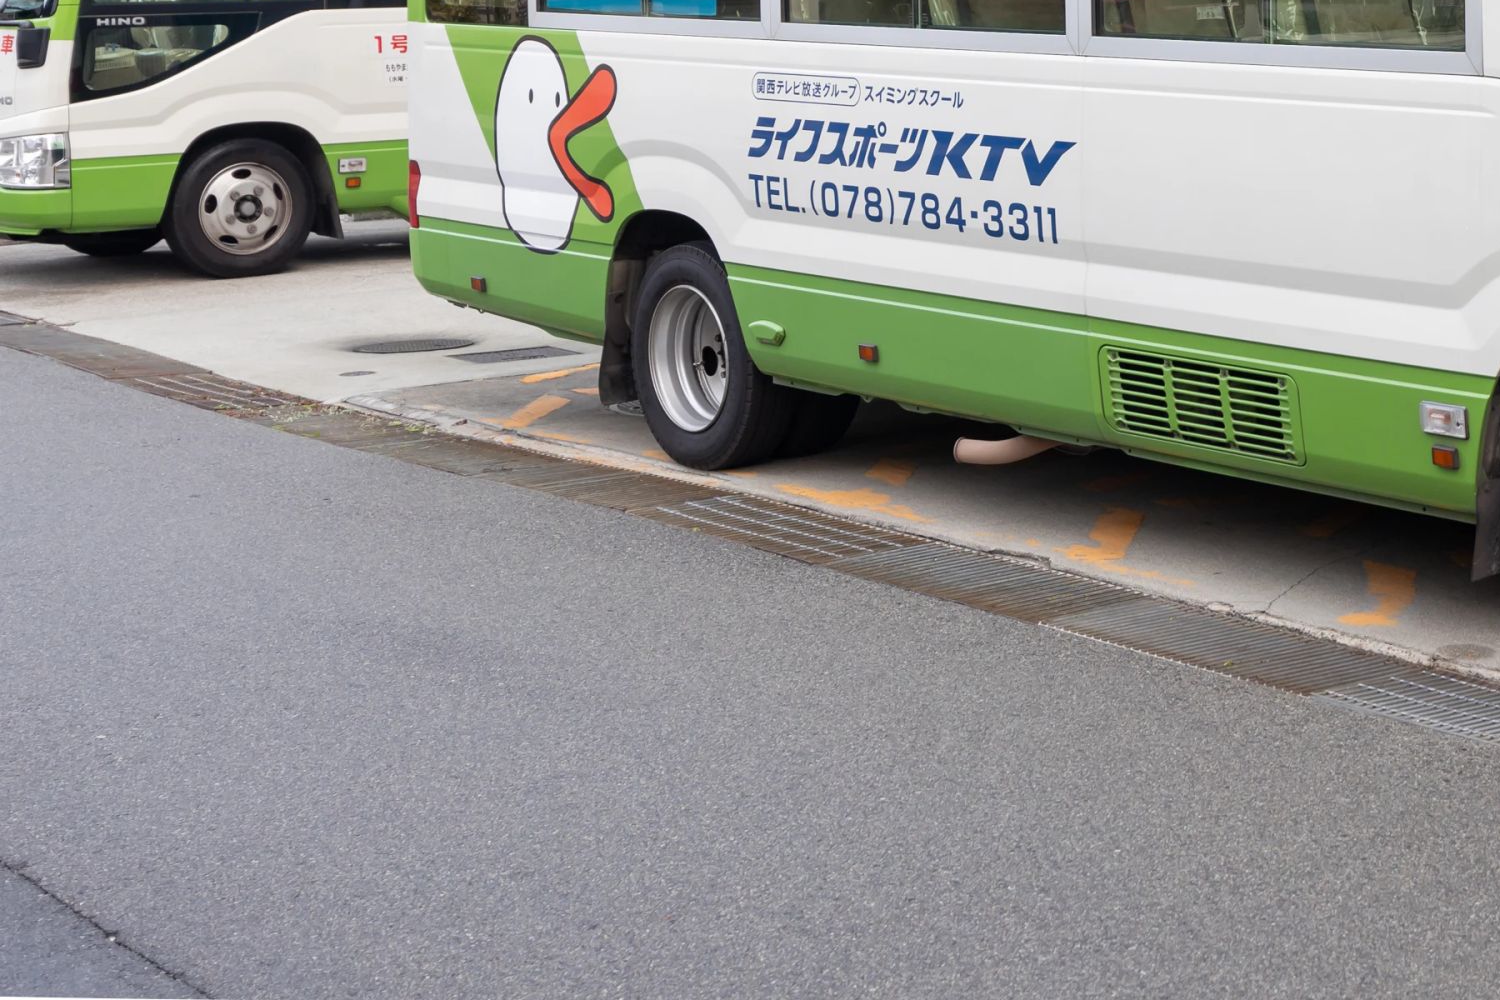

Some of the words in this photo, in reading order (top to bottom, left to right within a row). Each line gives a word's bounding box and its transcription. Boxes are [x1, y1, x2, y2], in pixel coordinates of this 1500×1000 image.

[97, 16, 146, 26] HINO
[757, 79, 857, 99] 関西テレビ放送グループ
[865, 86, 964, 108] スイミングスクール
